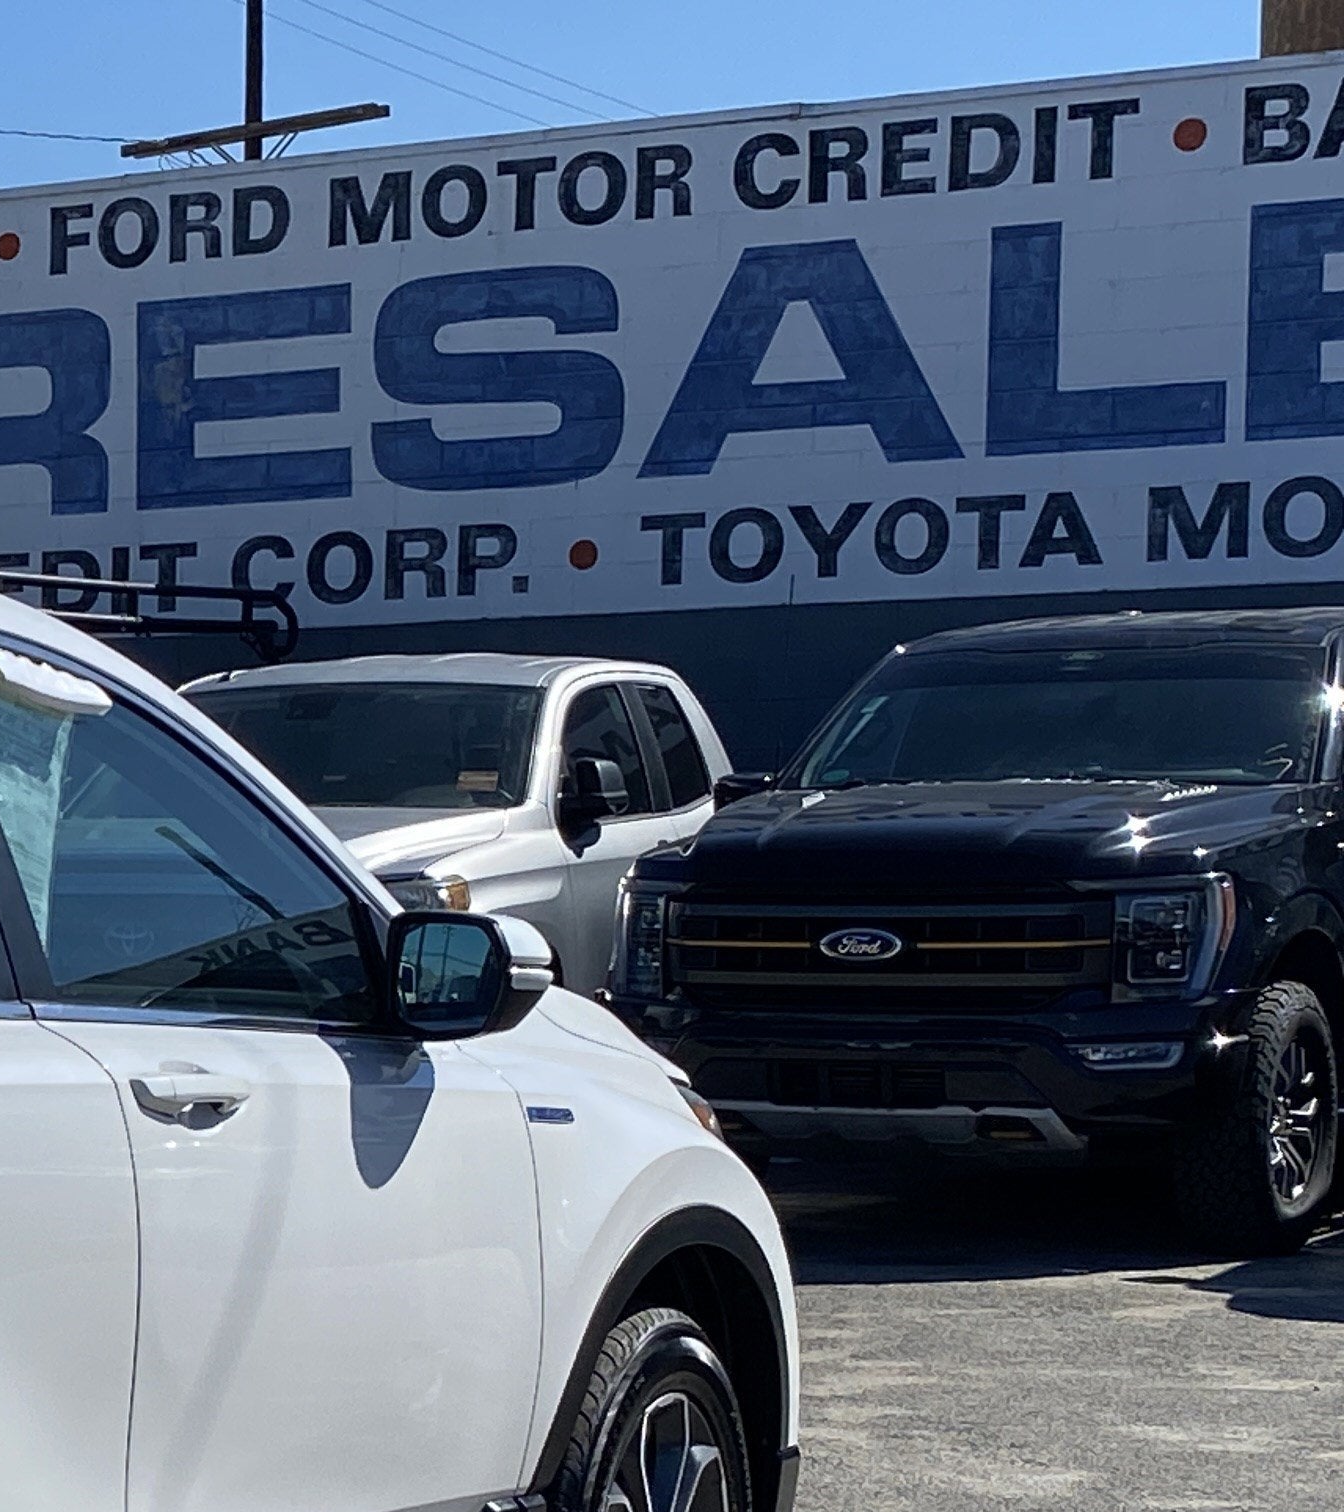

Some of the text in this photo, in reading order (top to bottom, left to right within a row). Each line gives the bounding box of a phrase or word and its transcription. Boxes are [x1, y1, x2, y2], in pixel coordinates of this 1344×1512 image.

[49, 183, 292, 276] FORD
[328, 144, 694, 249] MOTOR
[732, 98, 1141, 211] CREDIT
[231, 523, 530, 605] CORP.
[640, 490, 1104, 585] TOYOTA
[1146, 474, 1344, 562] MO
[837, 935, 882, 954] Ford
